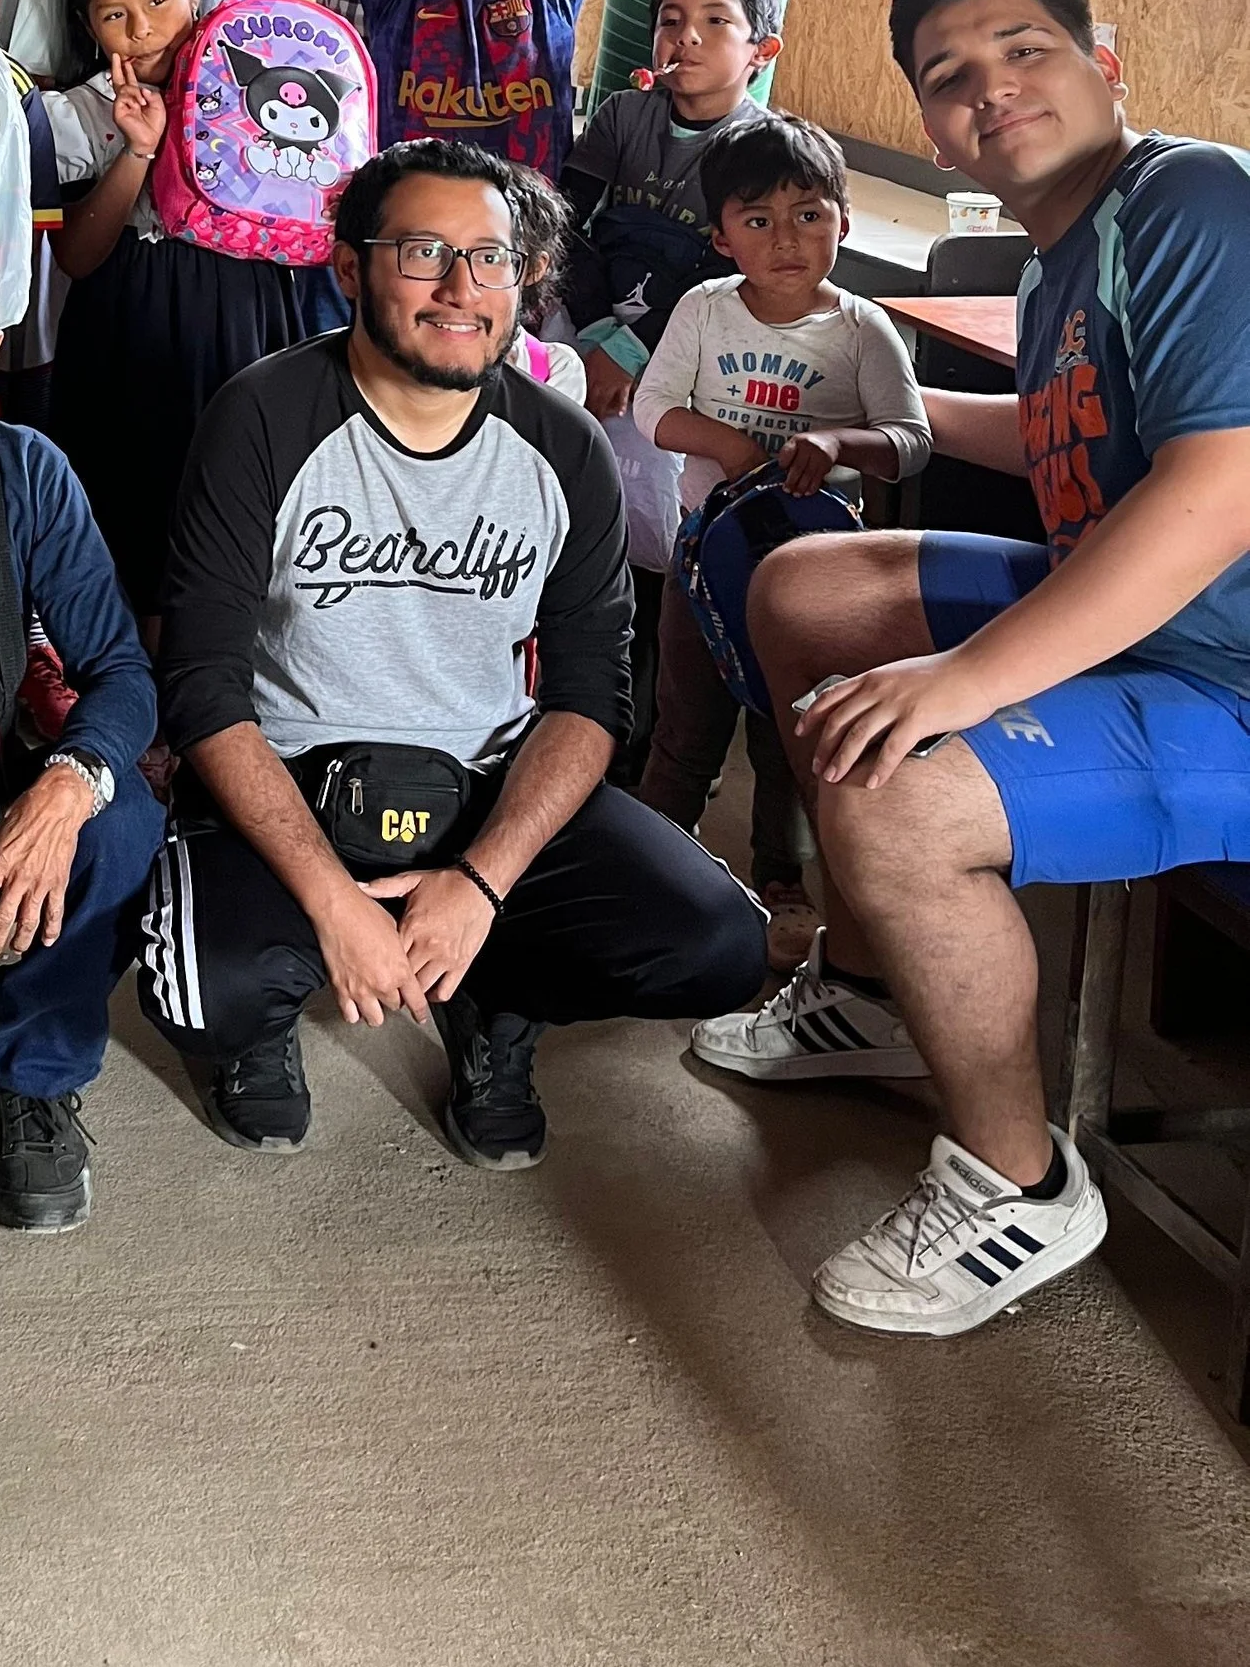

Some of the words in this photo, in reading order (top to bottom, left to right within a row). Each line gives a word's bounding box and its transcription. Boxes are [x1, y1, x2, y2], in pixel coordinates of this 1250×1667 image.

[223, 15, 350, 64] KUROMI
[398, 71, 554, 118] Rakuten
[717, 352, 825, 390] MOMMY
[745, 379, 800, 411] me
[717, 408, 750, 423] one
[755, 415, 811, 432] lucky
[293, 505, 537, 601] Bearcliff
[382, 809, 430, 842] CAT
[950, 1160, 996, 1197] adidas
